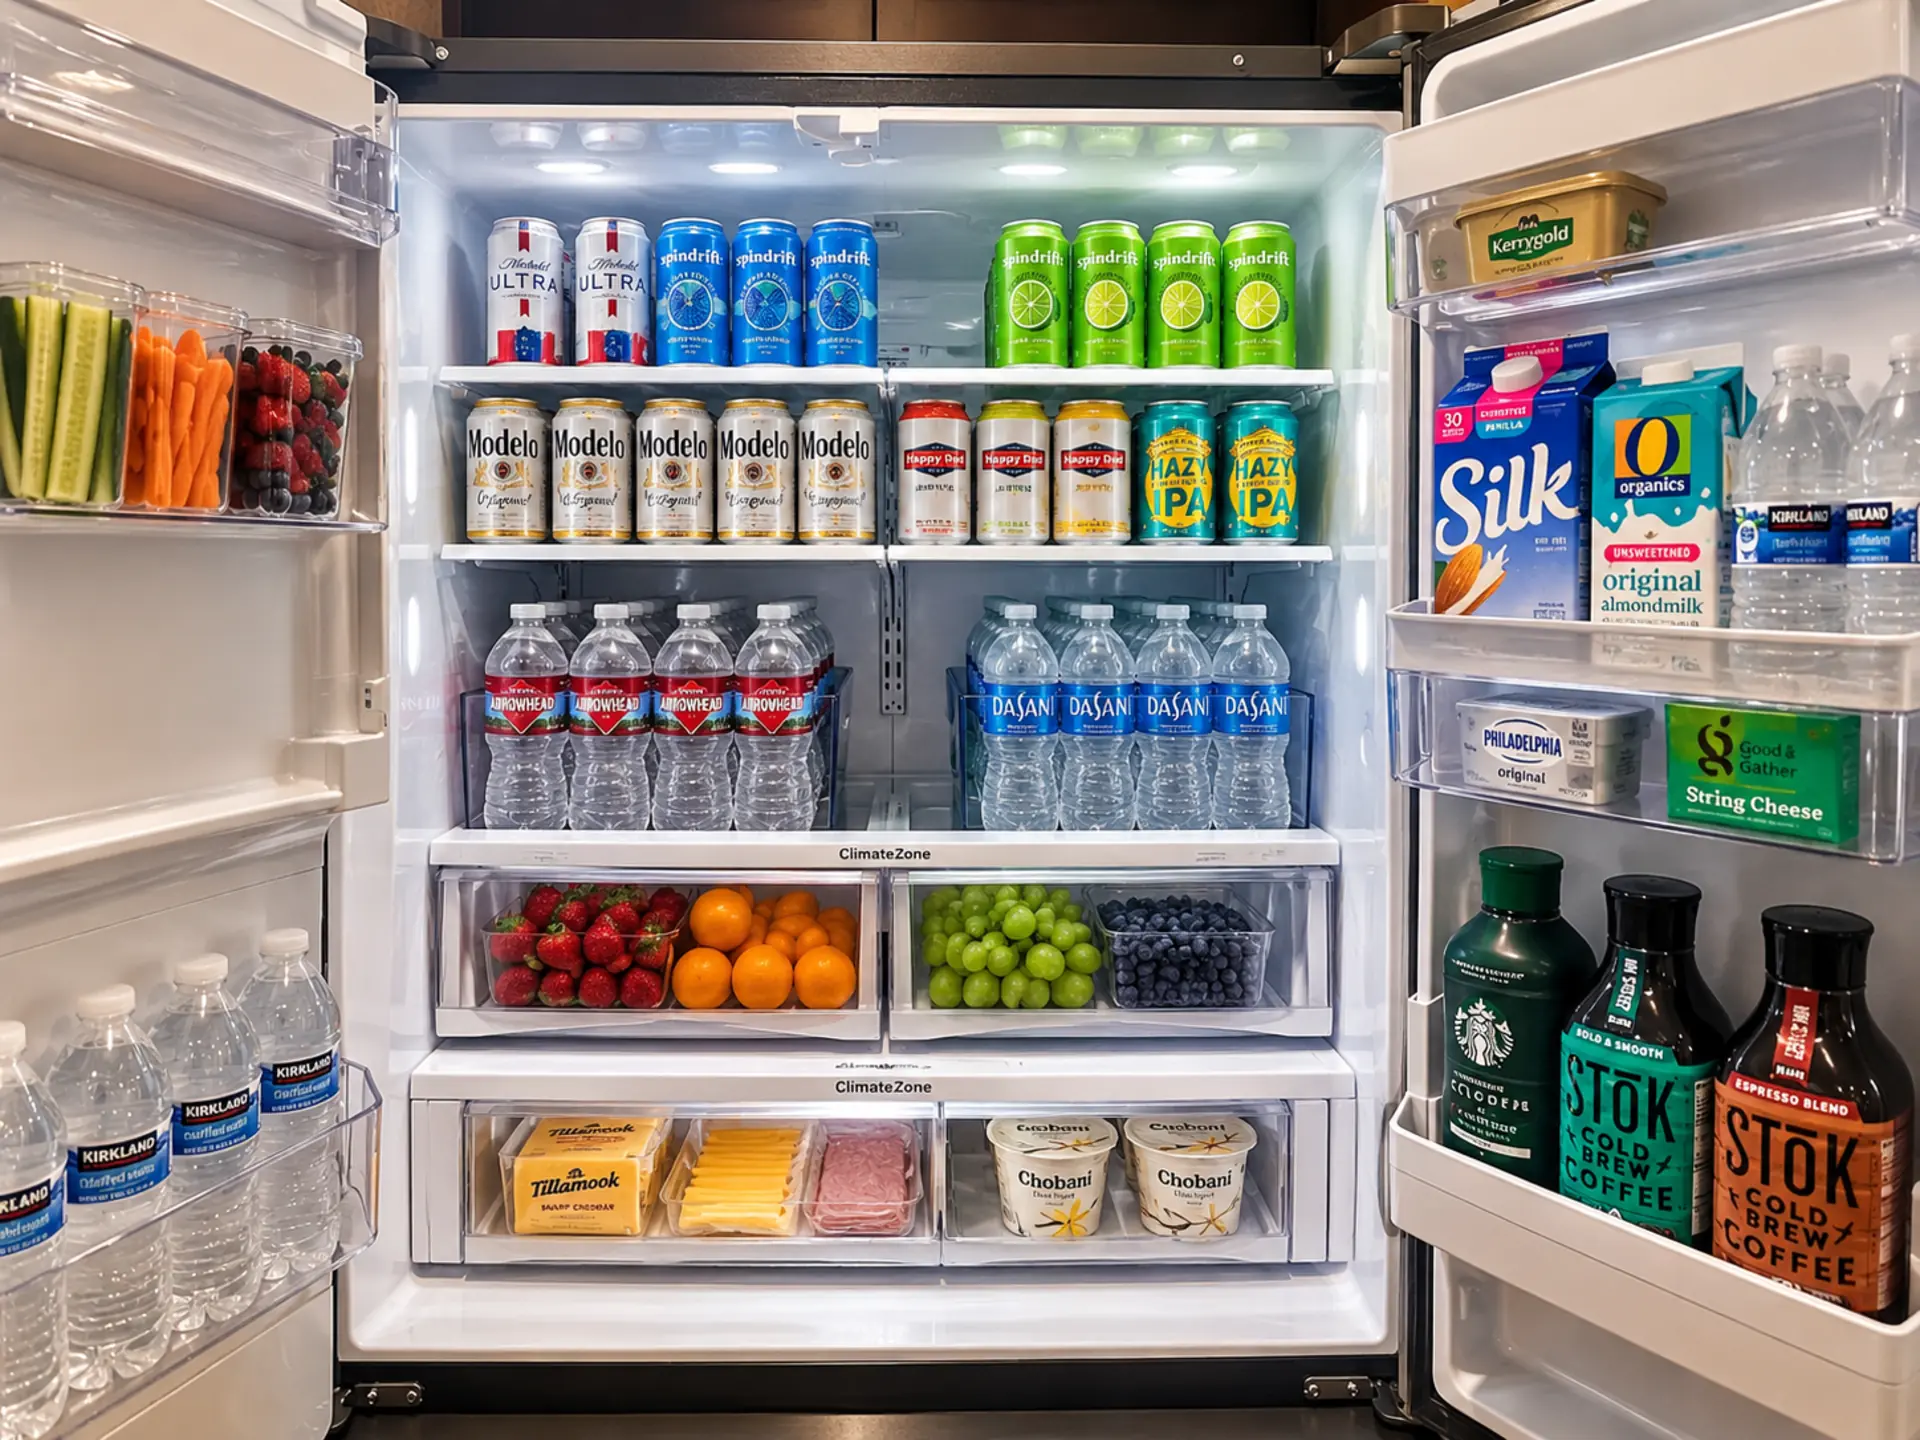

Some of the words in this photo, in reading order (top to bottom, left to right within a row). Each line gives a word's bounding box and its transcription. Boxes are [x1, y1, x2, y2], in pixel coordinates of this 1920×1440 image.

[1493, 225, 1569, 255] Kerrygold
[660, 248, 723, 267] spindrift
[735, 249, 796, 267] spindrift
[810, 249, 871, 267] spindrift
[1002, 249, 1064, 268] spindrift
[1077, 249, 1138, 270] spindrift
[1153, 250, 1216, 270] spindrift
[1228, 250, 1290, 270] spindrift
[490, 272, 558, 294] ULTRA
[579, 272, 647, 294] ULTRA
[1444, 412, 1462, 428] 30
[469, 428, 538, 459] Modelo
[555, 429, 625, 459] Modelo
[640, 429, 708, 460] Modelo
[721, 429, 789, 461] Modelo
[801, 430, 870, 461] Modelo
[1151, 456, 1206, 483] HAZY
[1235, 456, 1291, 483] HAZY
[1435, 442, 1581, 556] Silk
[1620, 476, 1685, 496] organics
[1153, 487, 1207, 517] IPA
[1238, 488, 1292, 518] IPA
[1602, 570, 1701, 597] original
[1601, 596, 1704, 615] almondmilk
[992, 691, 1054, 722] DASANI
[1069, 691, 1132, 721] DASANI
[1147, 691, 1209, 721] DASANI
[1225, 691, 1287, 722] DASANI
[1484, 729, 1563, 758] PHILADELPHIA
[1739, 741, 1782, 759] Good
[1498, 767, 1546, 784] original
[1739, 760, 1798, 778] Gather
[1686, 785, 1745, 814] String
[1750, 796, 1823, 821] Cheese
[839, 847, 931, 860] ClimateZone
[1615, 1041, 1664, 1060] SMOOTH
[835, 1080, 932, 1093] ClimateZone
[1735, 1078, 1799, 1106] ESPRESSO
[1803, 1097, 1849, 1116] BLEND
[83, 1137, 155, 1163] KIRKLAND
[1582, 1126, 1649, 1160] COLD
[1582, 1146, 1650, 1180] BREW
[530, 1171, 620, 1197] Tillamook
[1018, 1169, 1092, 1190] Chobani
[1157, 1169, 1232, 1189] Chobani
[1565, 1155, 1673, 1211] COFFEE
[1746, 1187, 1827, 1226] COLD
[1746, 1207, 1829, 1251] BREW
[1724, 1218, 1856, 1286] COFFEE
